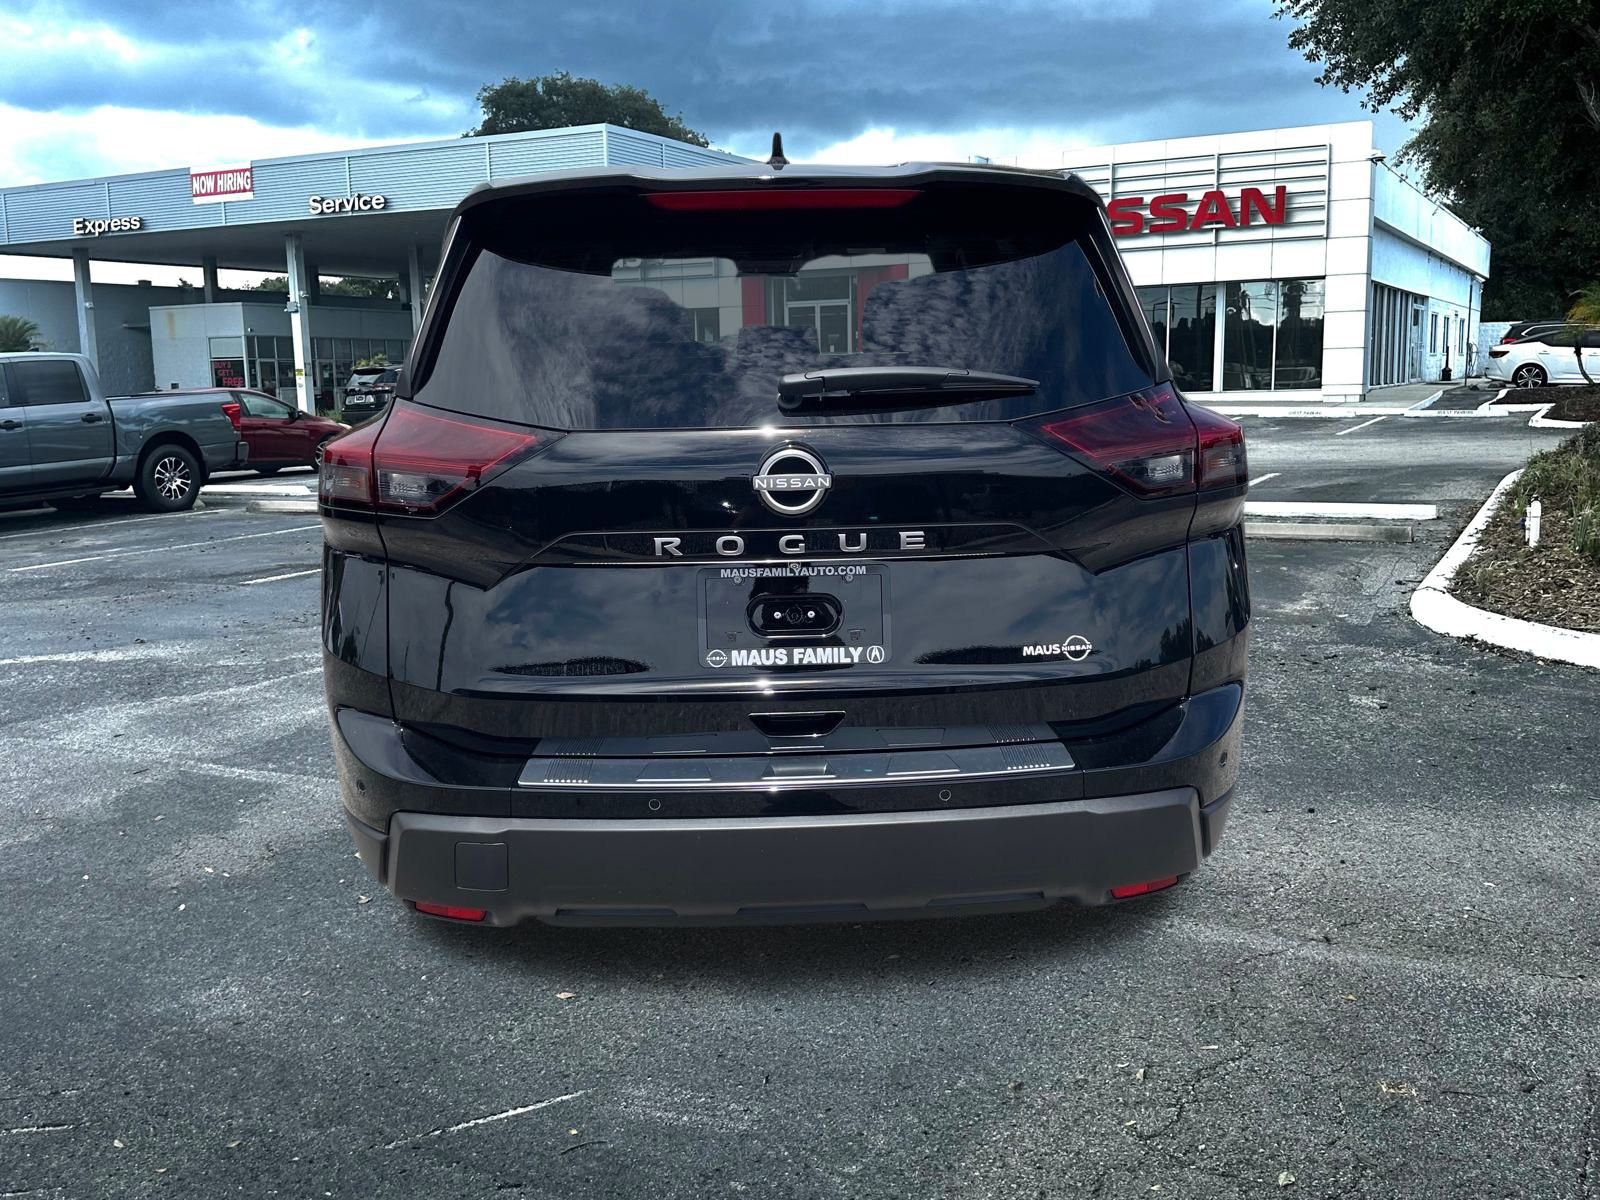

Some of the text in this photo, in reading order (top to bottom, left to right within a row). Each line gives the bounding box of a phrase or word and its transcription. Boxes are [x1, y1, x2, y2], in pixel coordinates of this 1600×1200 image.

[192, 170, 251, 195] NOW HIRING
[309, 194, 386, 216] Service
[72, 215, 141, 236] Express
[222, 377, 245, 387] FREE
[754, 476, 831, 489] NISSAN
[653, 530, 926, 556] ROGUE
[720, 565, 867, 578] MAUSFAMILYAUTO.COM
[731, 649, 788, 666] MAUS
[793, 646, 863, 664] FAMILY
[1022, 643, 1093, 656] MAUS NISSAN
